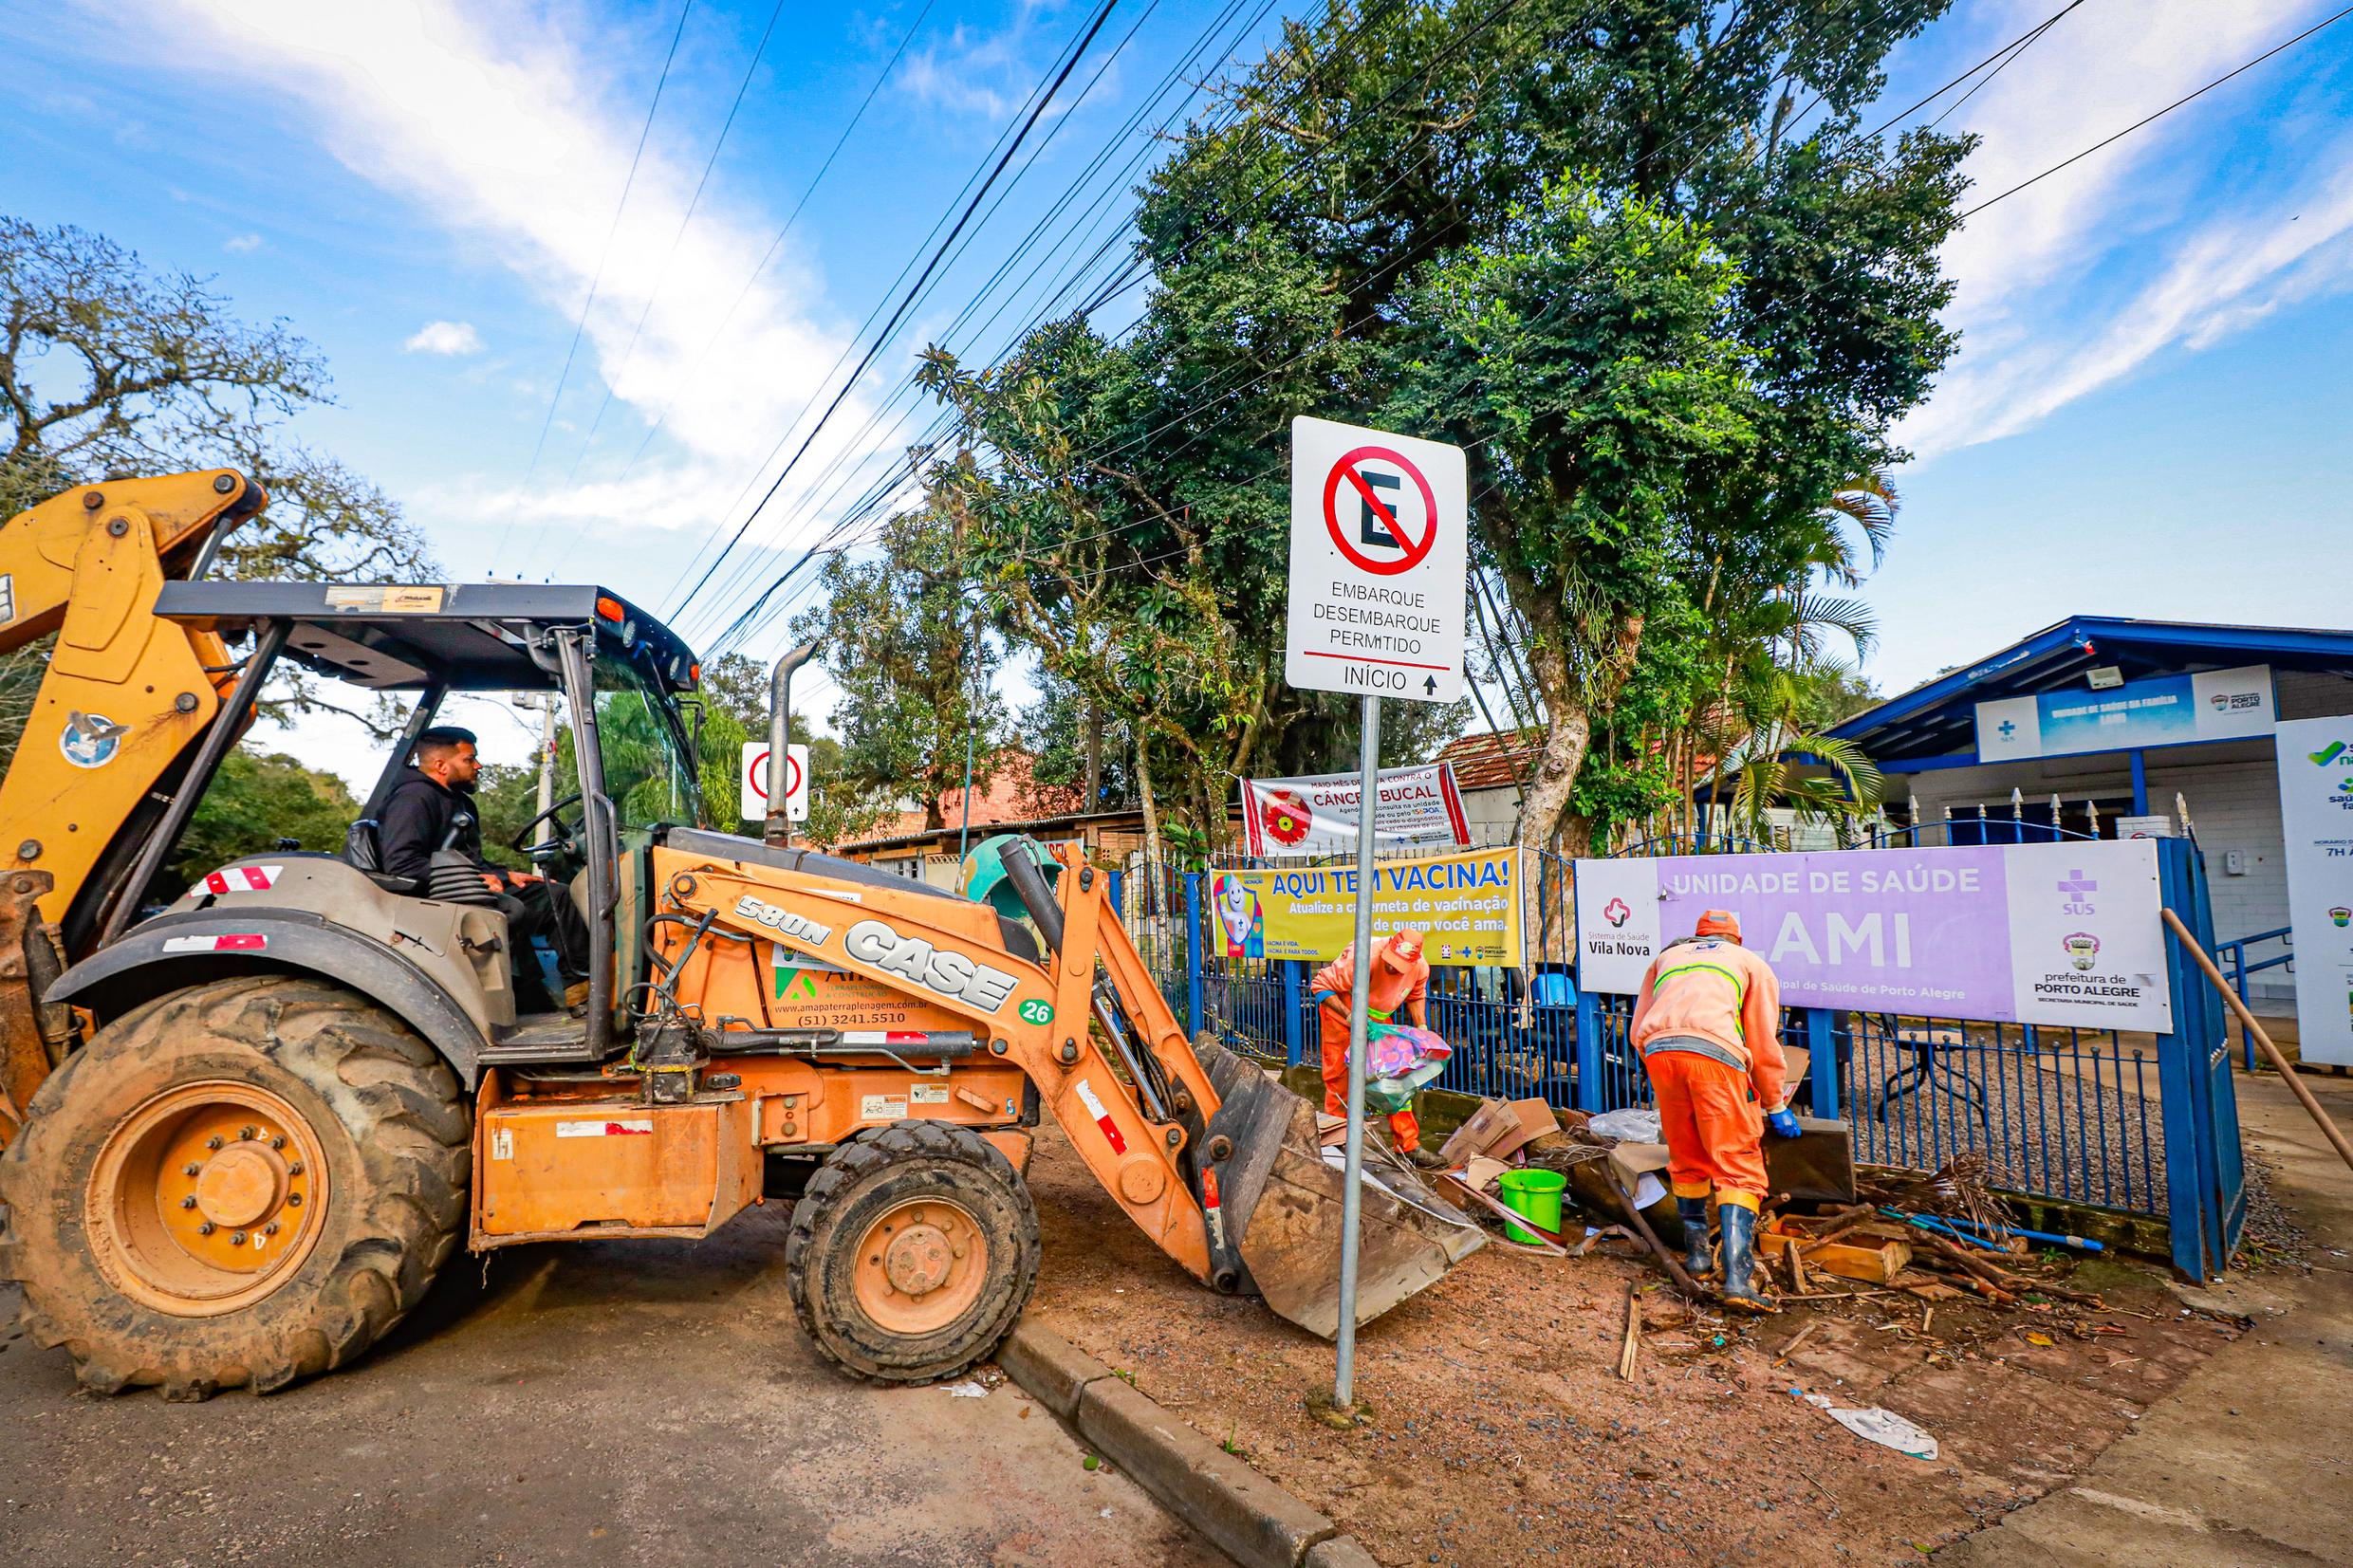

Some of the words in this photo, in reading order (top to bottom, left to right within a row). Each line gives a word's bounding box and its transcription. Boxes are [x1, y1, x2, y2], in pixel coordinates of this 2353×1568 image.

[1331, 581, 1425, 609] EMBARQUE
[1313, 602, 1441, 634] DESEMBARQUE
[1330, 628, 1421, 655] PERMITIDO
[1343, 664, 1407, 691] INÍCIO
[2231, 695, 2261, 704] PORTO
[2232, 701, 2261, 710] ALEGRE
[1388, 773, 1421, 784] CONTRA
[1380, 785, 1437, 802] BUCAL
[2325, 847, 2345, 857] 7H
[1271, 871, 1325, 900] AQUI
[1387, 860, 1510, 892] VACINA!
[1672, 870, 1800, 895] UNIDADE
[1809, 870, 1851, 894] DE
[1861, 862, 1981, 894] SAÚDE
[1288, 900, 1334, 914] Atualize
[1335, 903, 1343, 913] a
[1414, 898, 1430, 913] de
[1434, 895, 1509, 915] vacinação
[2063, 903, 2096, 915] SUS
[734, 895, 832, 947] 580N
[1373, 918, 1390, 932] de
[1434, 916, 1470, 932] você
[1473, 918, 1509, 932] ama.
[1588, 932, 1615, 940] Sistema
[1616, 932, 1626, 940] de
[1626, 932, 1650, 941] Saúde
[1588, 941, 1614, 954] Vila
[1616, 942, 1650, 957] Nova
[843, 918, 1020, 1015] CASE
[2045, 971, 2106, 984] prefeitura
[2109, 973, 2127, 985] de
[1803, 980, 1818, 991] de
[1821, 981, 1858, 993] Saúde
[1861, 983, 1877, 994] de
[1880, 985, 1917, 997] Porto
[1919, 987, 1966, 1001] Alegre
[2034, 983, 2081, 995] PORTO
[2084, 986, 2141, 998] ALEGRE
[774, 1001, 929, 1014] www.amapaterraplenagem.com.br
[1023, 1002, 1050, 1023] 26
[797, 1014, 827, 1028] (51)
[831, 1012, 906, 1025] 3241.5510
